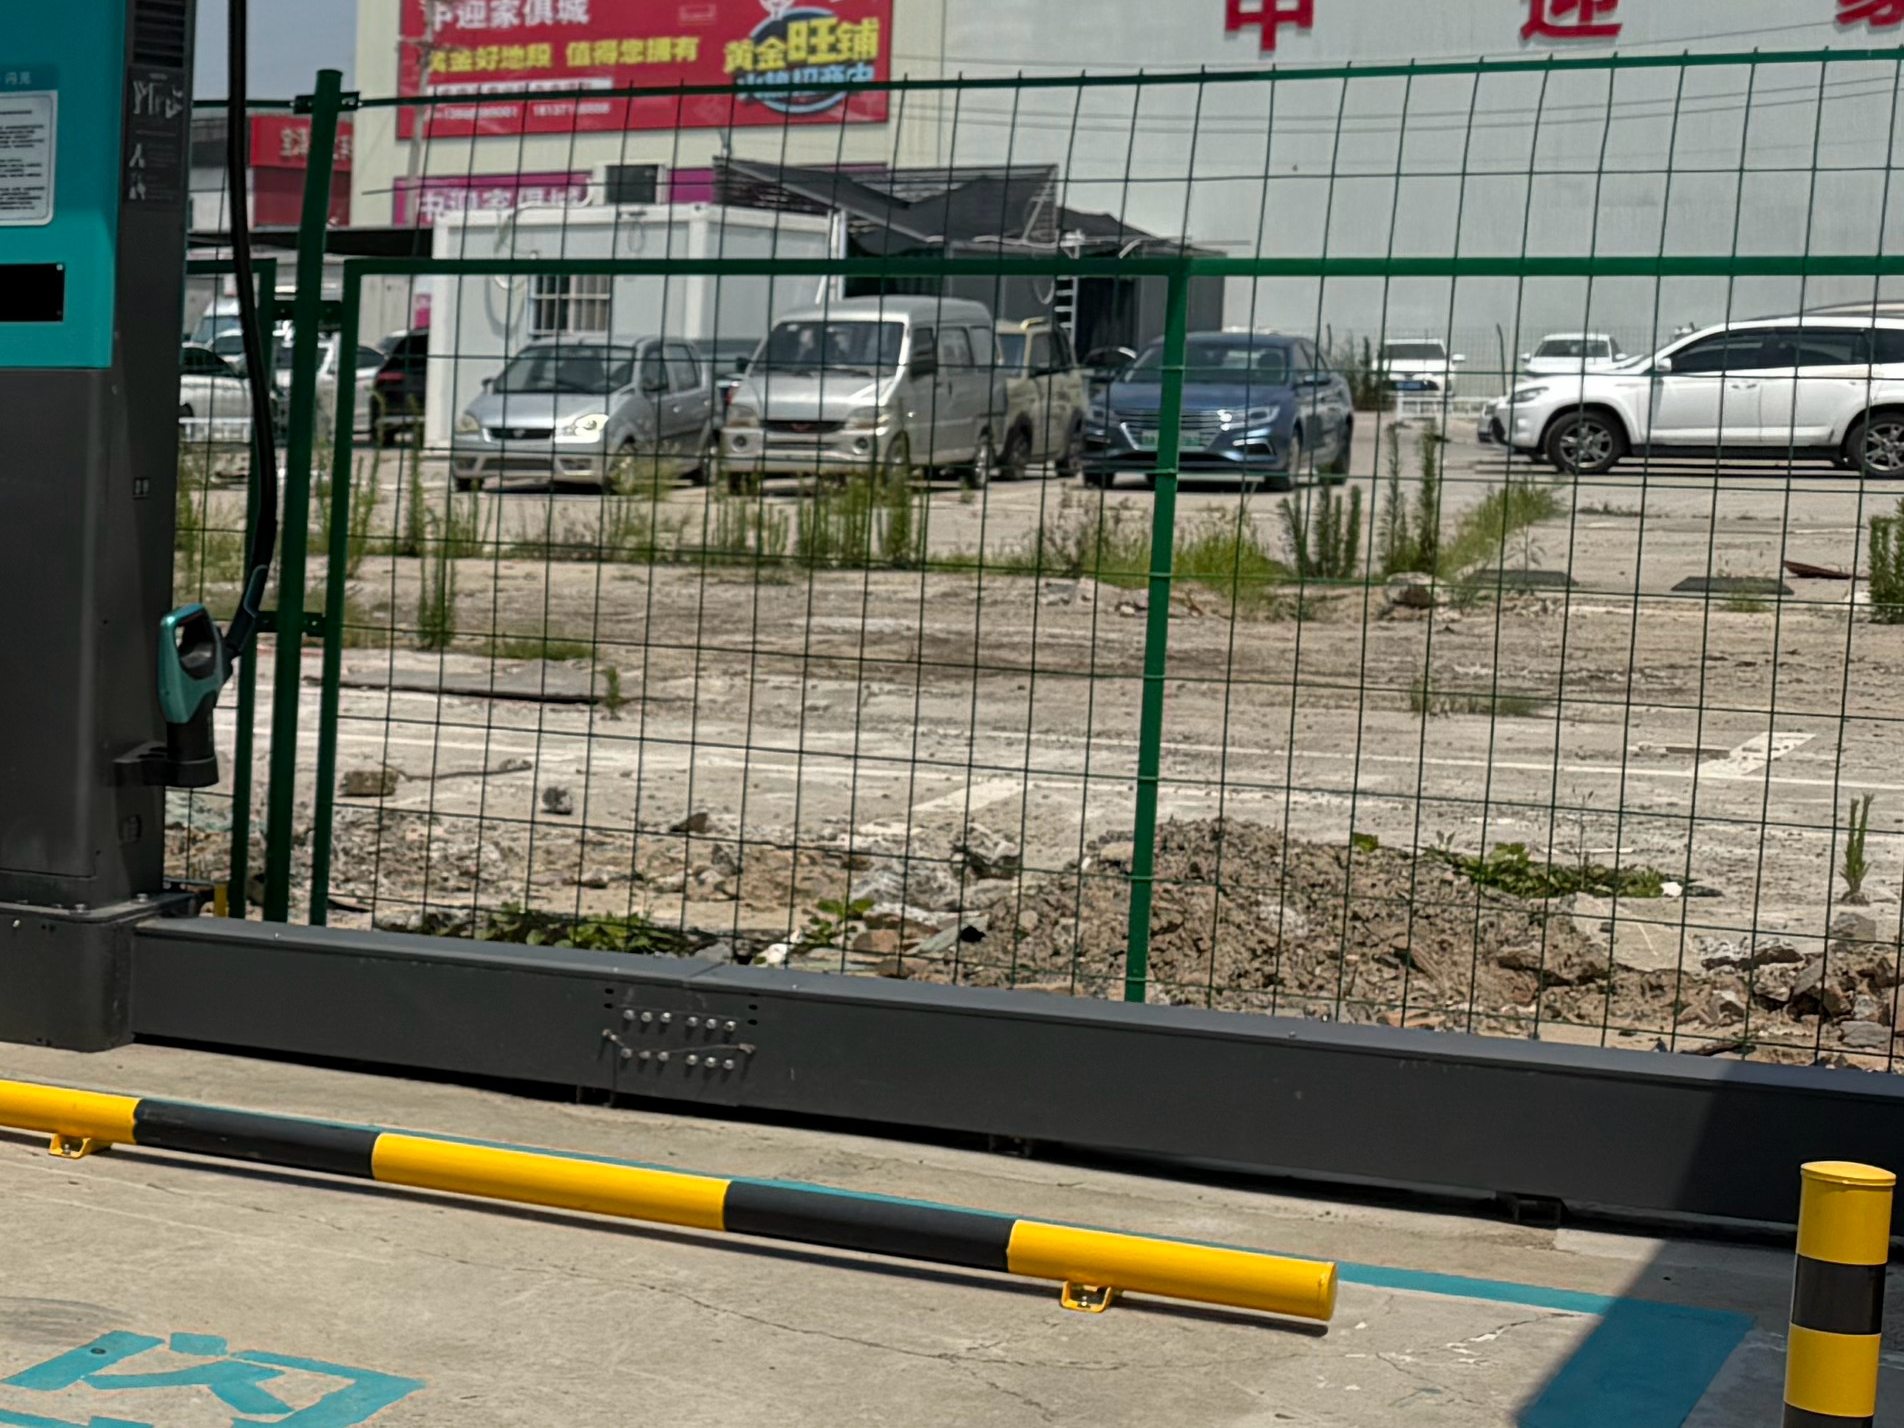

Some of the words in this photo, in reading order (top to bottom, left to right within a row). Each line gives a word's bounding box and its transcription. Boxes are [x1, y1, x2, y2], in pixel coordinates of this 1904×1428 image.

[565, 36, 701, 69] 值得您拥有
